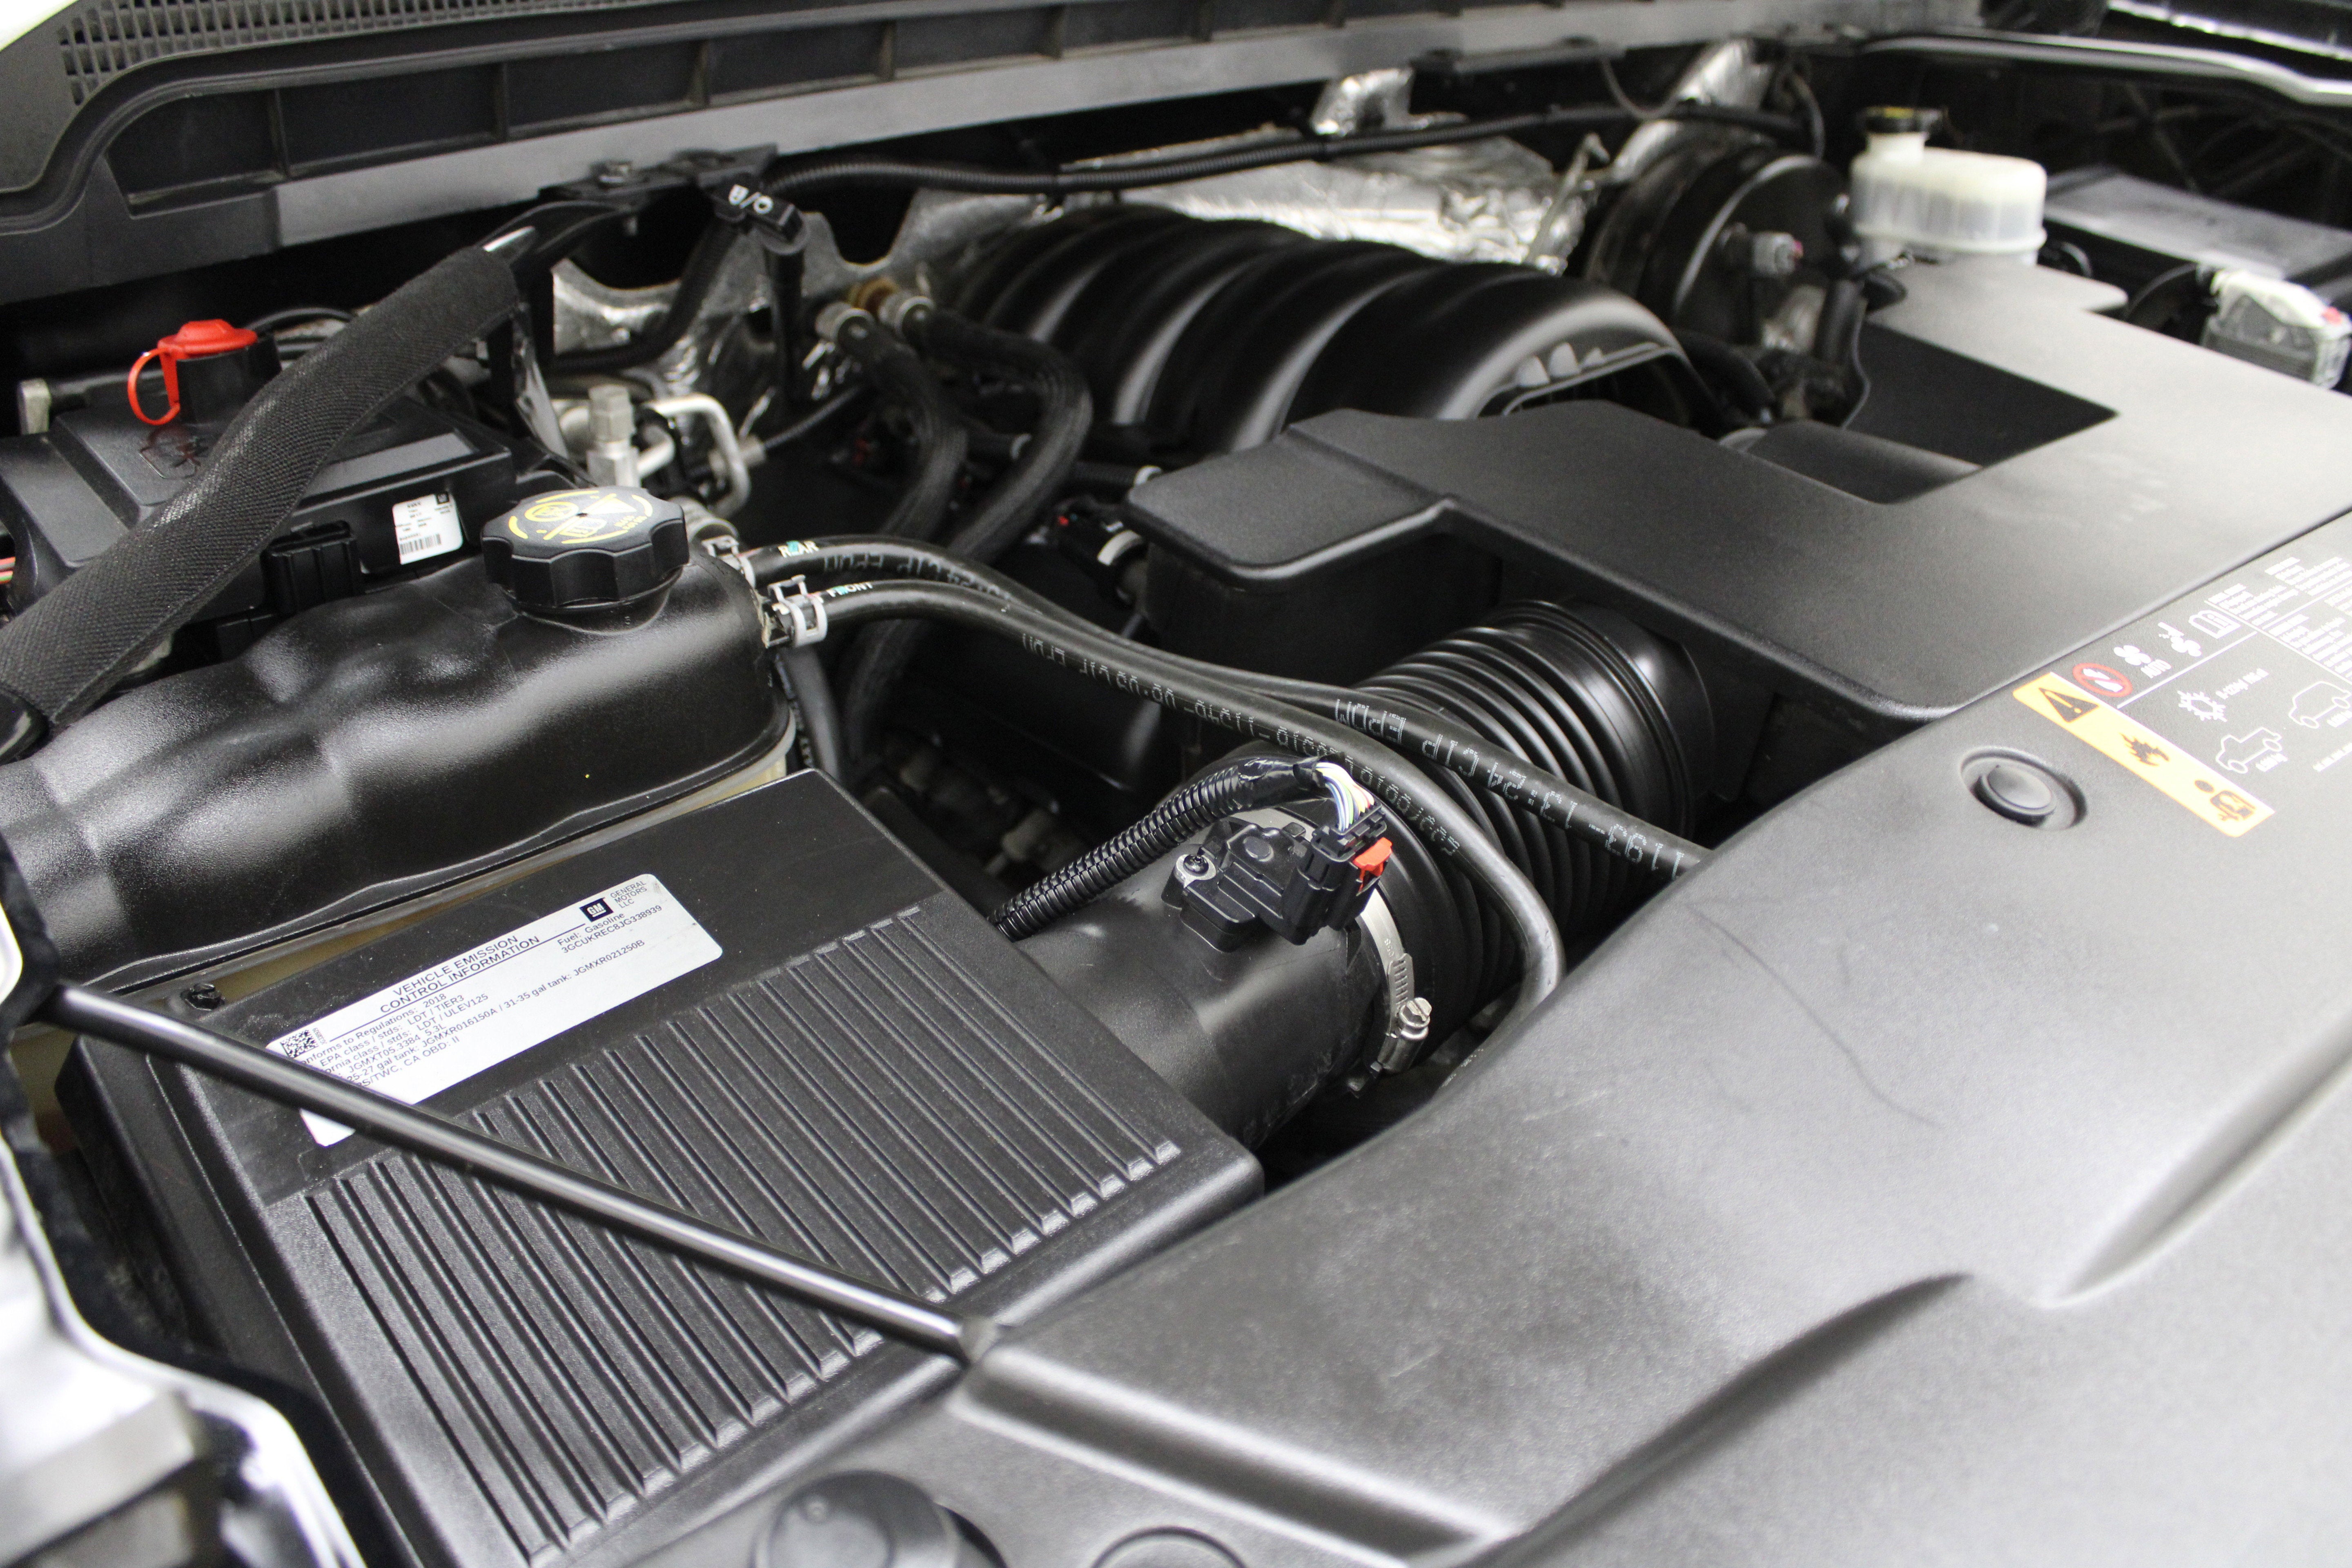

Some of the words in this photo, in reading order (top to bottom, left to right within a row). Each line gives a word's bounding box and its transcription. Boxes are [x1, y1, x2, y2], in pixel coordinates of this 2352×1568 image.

[1334, 698, 1407, 746] EPDM
[586, 903, 605, 915] GM
[610, 880, 647, 898] GENERAL
[614, 886, 647, 903] MOTORS
[619, 898, 635, 909] LLC
[557, 932, 581, 946] Fuel:
[585, 913, 625, 933] Gasoline
[380, 980, 448, 1013] CONTROL
[449, 936, 540, 982] INFORMATION
[393, 965, 452, 996] VEHICLE
[454, 935, 519, 969] EMISSION
[377, 1057, 392, 1070] gal
[394, 1046, 419, 1060] tank:
[422, 1008, 498, 1047] JGMXR016150A
[503, 992, 531, 1009] 31-35
[532, 984, 547, 997] gal
[548, 973, 572, 988] tank:
[573, 940, 645, 977] JGMXR021250B
[301, 1044, 342, 1065] onforms
[355, 1008, 418, 1040] Regulations:
[423, 993, 446, 1008] 2018
[320, 1053, 342, 1067] EPA
[344, 1040, 370, 1055] class
[378, 1025, 402, 1039] stds:
[407, 1011, 427, 1025] LDT
[434, 995, 464, 1011] TIER3
[325, 1059, 351, 1073] ornia
[354, 1046, 379, 1060] class
[387, 1031, 411, 1045] stds:
[416, 1017, 436, 1030] LDT
[444, 993, 488, 1017] ULEV125
[425, 1024, 447, 1036] 5.3L
[404, 1056, 421, 1066] CA
[423, 1042, 451, 1057] OBD:
